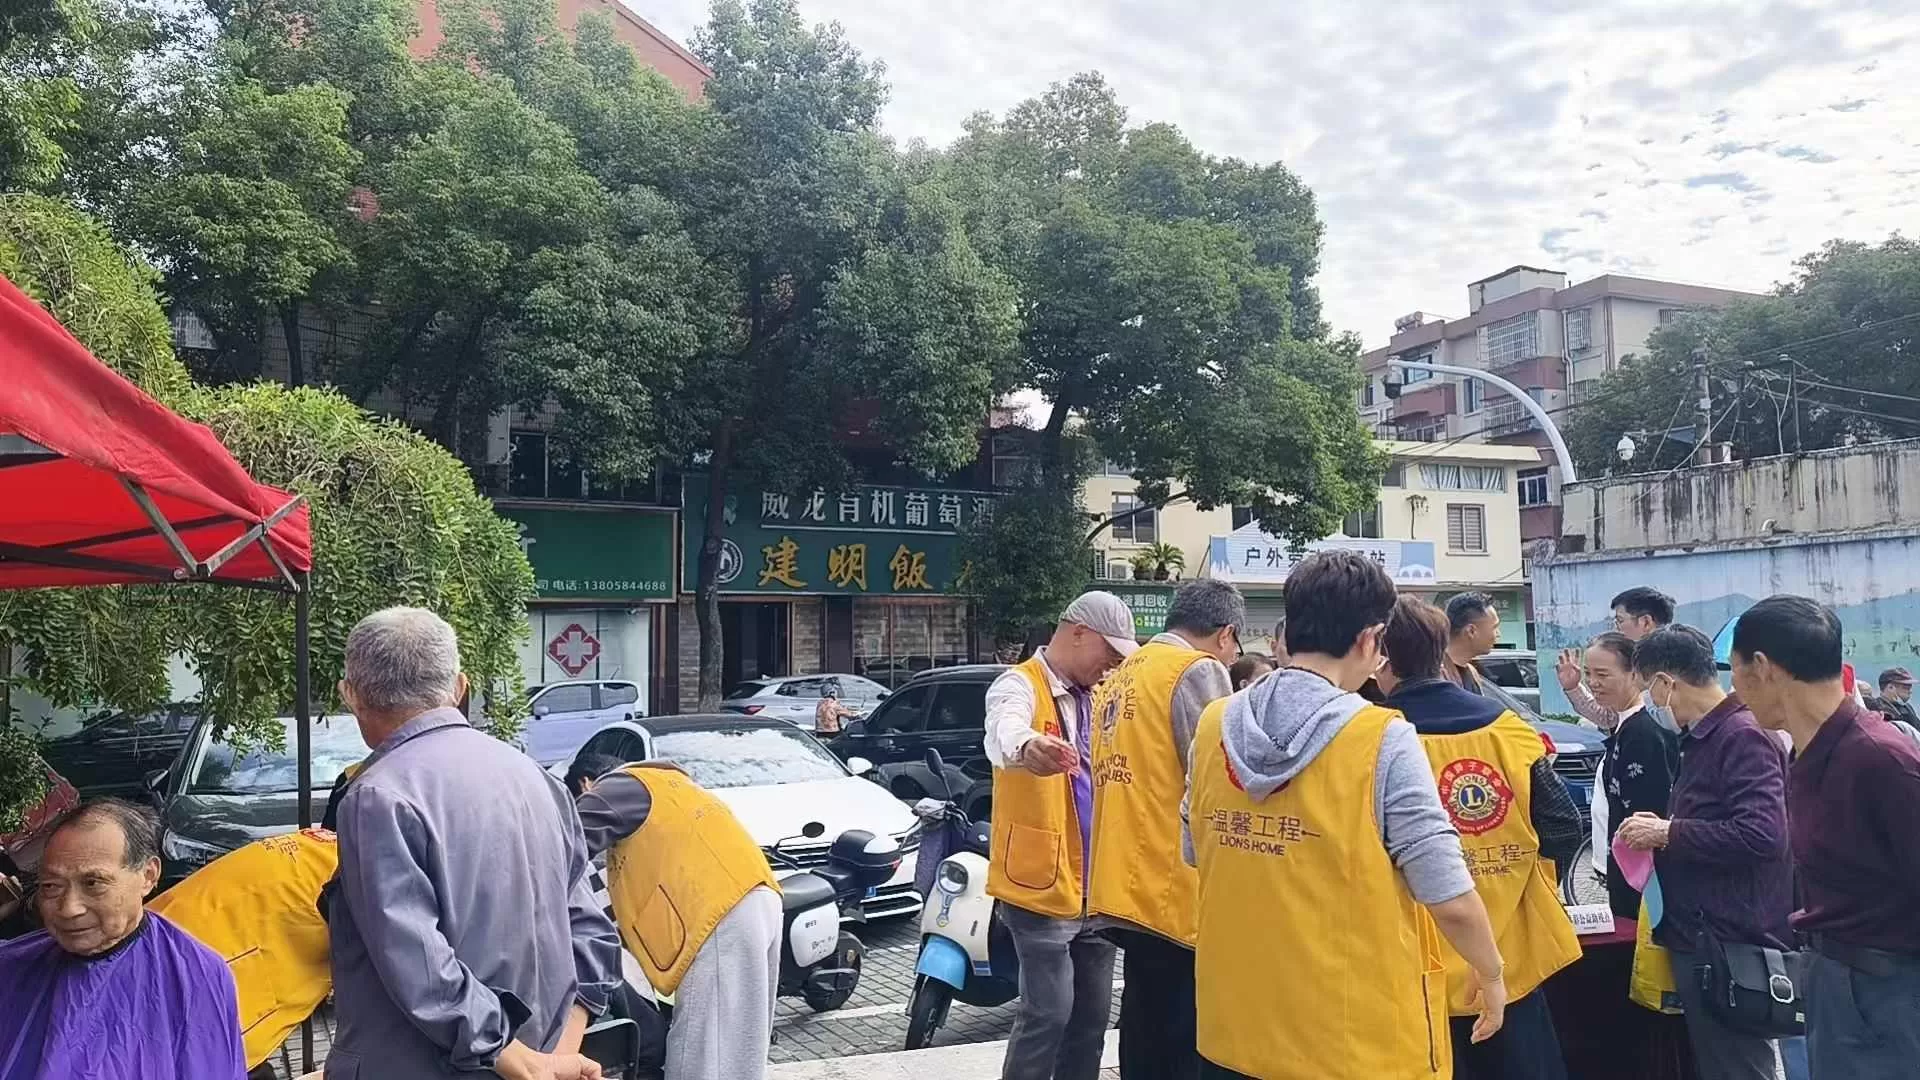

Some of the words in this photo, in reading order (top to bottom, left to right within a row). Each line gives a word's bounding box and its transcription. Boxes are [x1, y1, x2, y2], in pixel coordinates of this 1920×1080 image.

[1220, 835, 1250, 850] LIONS
[1251, 842, 1285, 856] HOME
[1481, 865, 1511, 876] HOME
